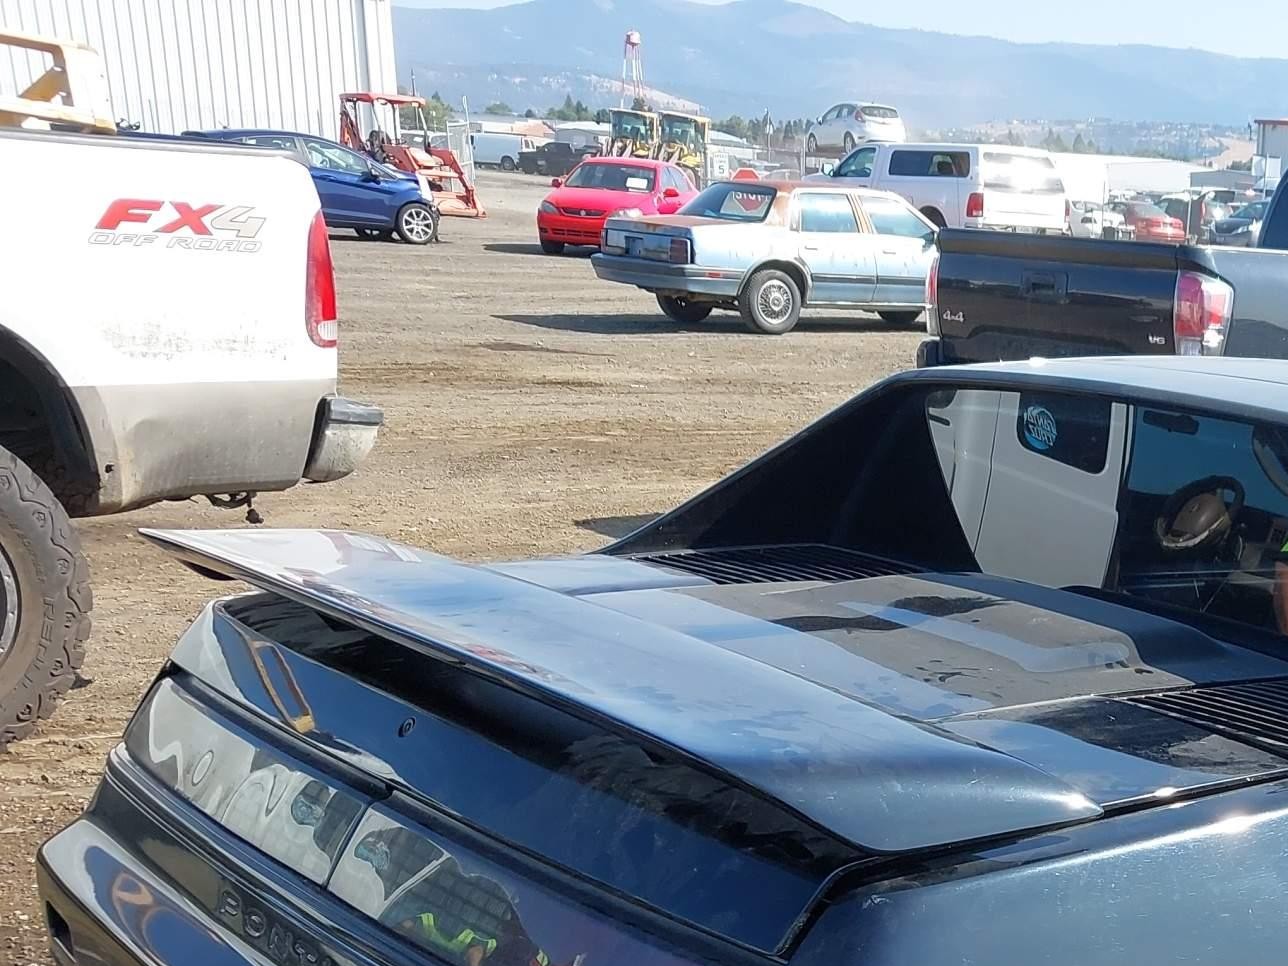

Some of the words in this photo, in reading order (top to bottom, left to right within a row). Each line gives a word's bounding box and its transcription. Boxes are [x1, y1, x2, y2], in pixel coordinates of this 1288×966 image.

[94, 198, 267, 239] FX4
[88, 231, 158, 247] OFF
[166, 236, 263, 253] ROAD
